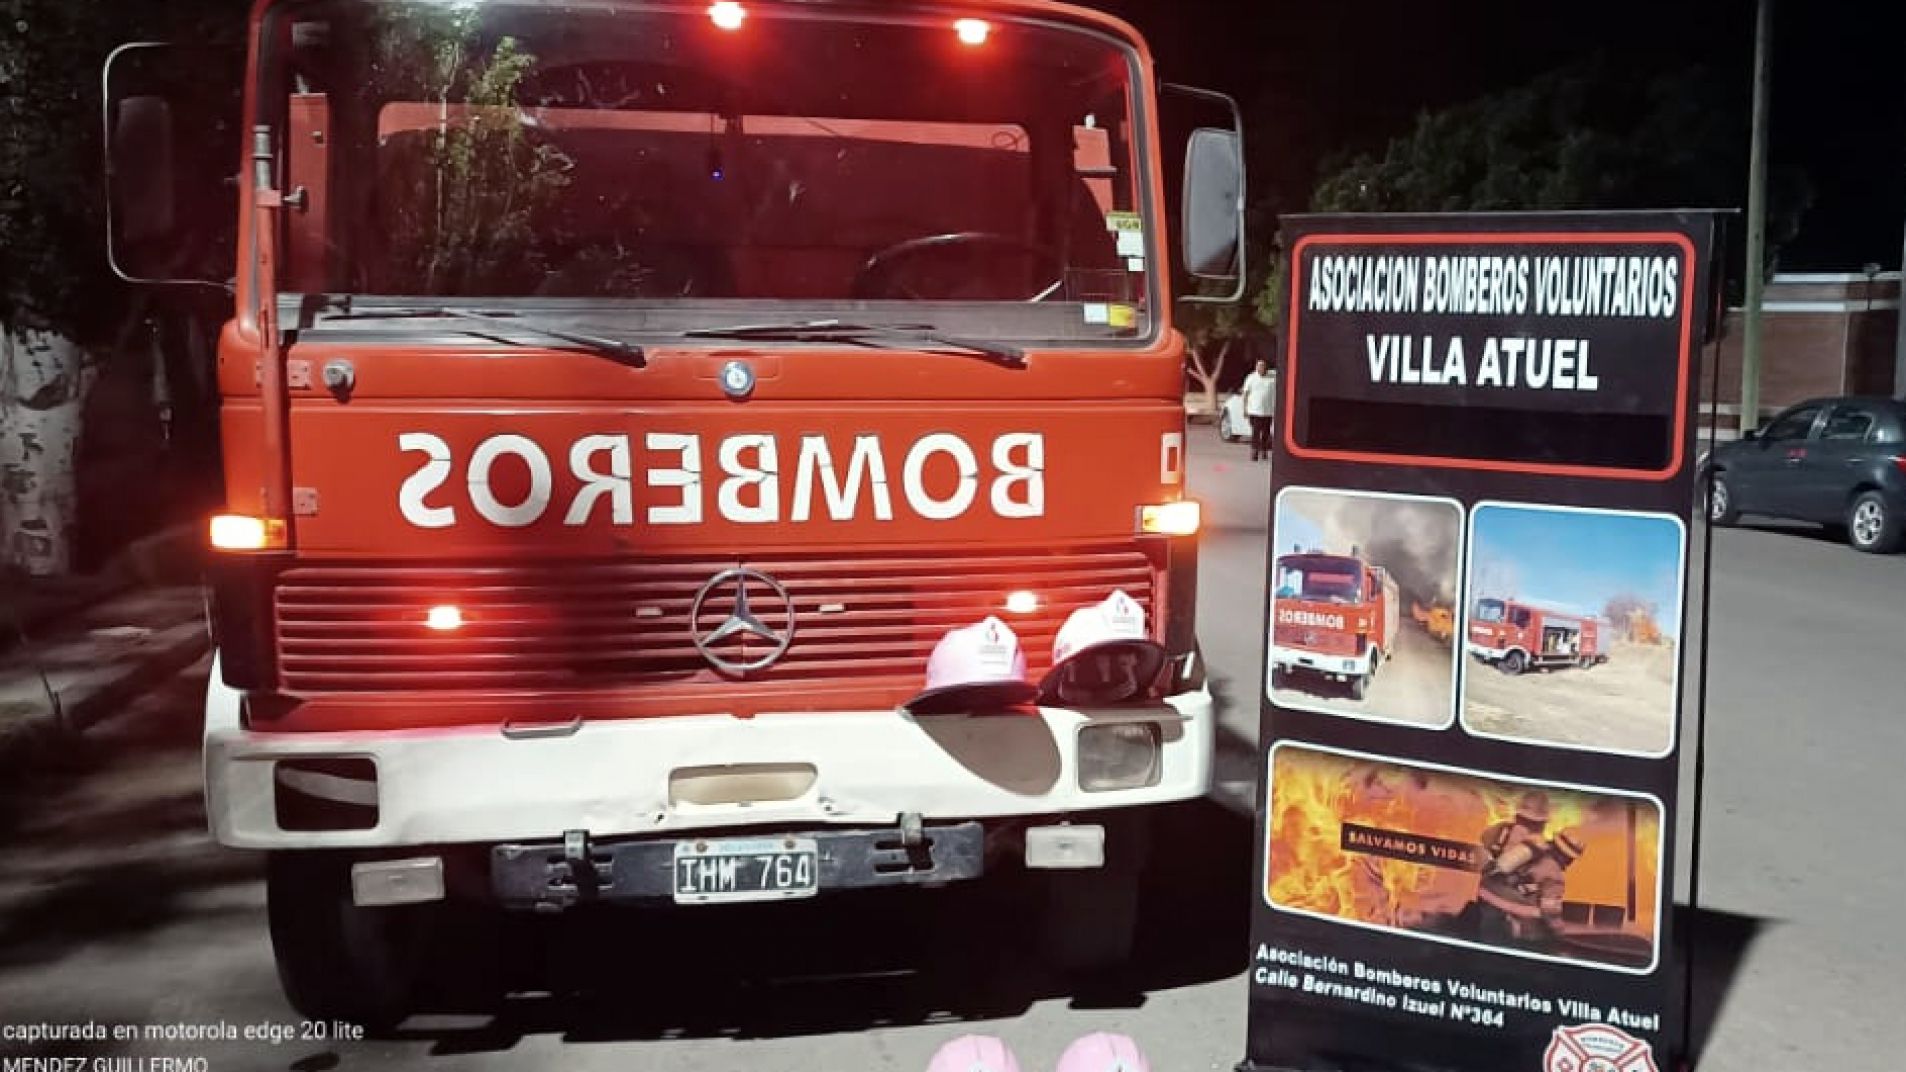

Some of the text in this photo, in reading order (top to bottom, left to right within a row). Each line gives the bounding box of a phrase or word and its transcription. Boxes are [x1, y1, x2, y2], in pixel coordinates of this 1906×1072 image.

[1309, 256, 1677, 319] ASOCIACION BOMBEROS VOLUNTARIOS
[1367, 335, 1598, 391] VILLA ATUEL
[679, 854, 811, 893] IHM 764
[1349, 831, 1475, 863] SALVAMOS VIDAS
[1255, 966, 1299, 989] Calle
[1302, 974, 1397, 1008] Bernardino
[1402, 993, 1446, 1018] Izuel
[1256, 943, 1660, 1031] Asociación Bomberos Voluntarios Villa Atuel
